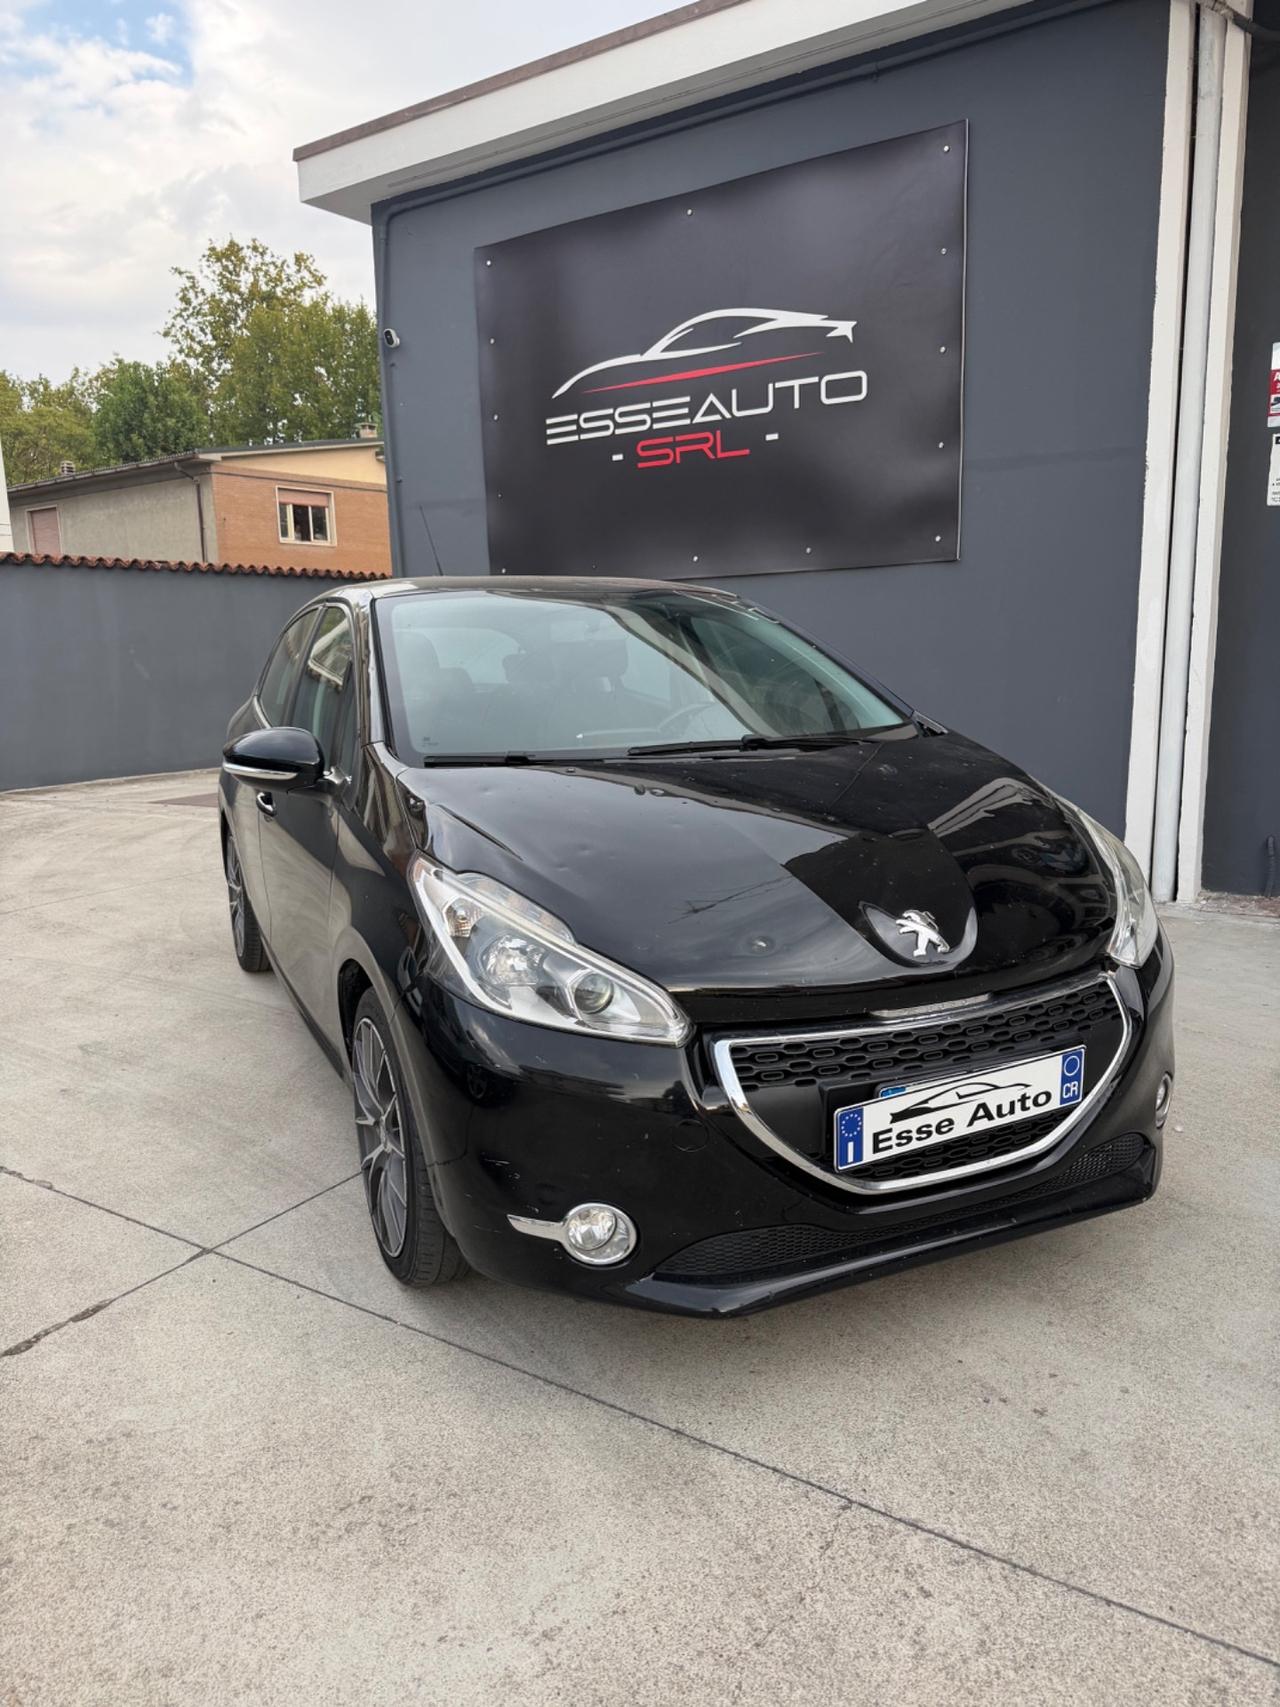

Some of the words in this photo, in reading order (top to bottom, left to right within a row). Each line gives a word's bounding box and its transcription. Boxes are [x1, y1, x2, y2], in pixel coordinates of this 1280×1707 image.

[546, 370, 868, 445] ESSEAUTO
[636, 430, 750, 468] SRL
[1063, 1082, 1079, 1098] CR
[872, 1117, 955, 1154] Esse
[967, 1089, 1052, 1127] Auto
[847, 1142, 854, 1163] I
